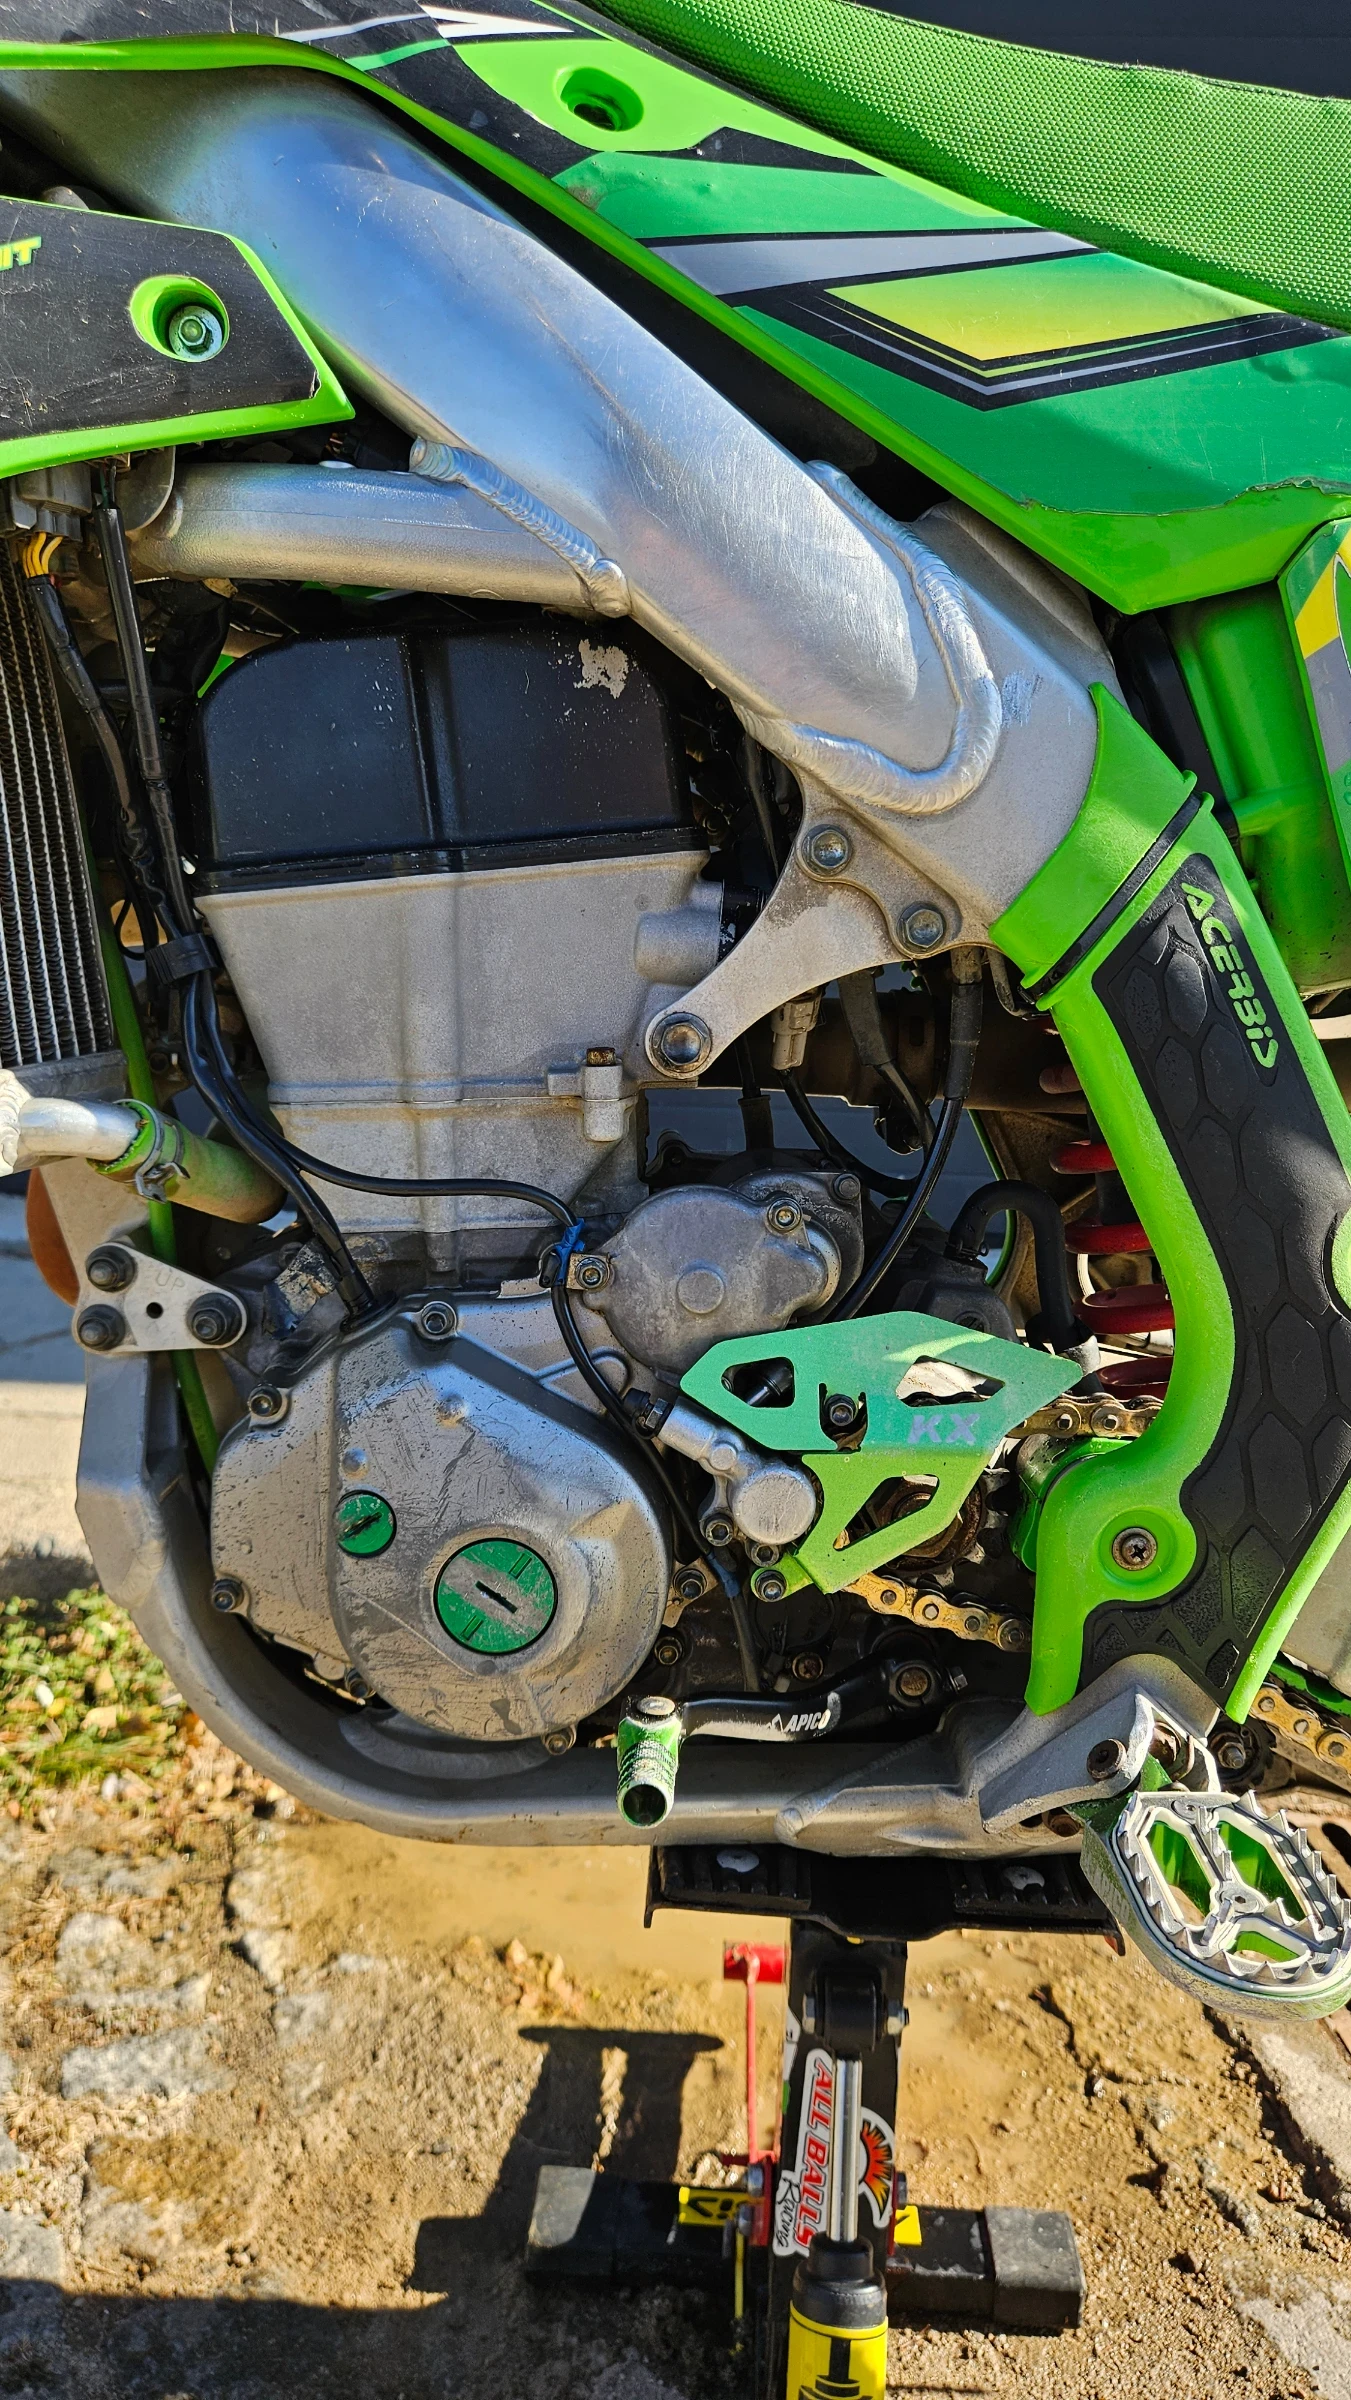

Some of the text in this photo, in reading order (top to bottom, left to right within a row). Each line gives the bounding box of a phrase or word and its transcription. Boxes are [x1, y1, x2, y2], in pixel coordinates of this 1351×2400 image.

[0, 236, 42, 271] IT
[155, 1268, 186, 1291] UP
[907, 1413, 980, 1445] KX
[784, 1709, 832, 1731] APICO
[809, 2057, 833, 2130] ALL
[776, 2176, 801, 2248] Racing
